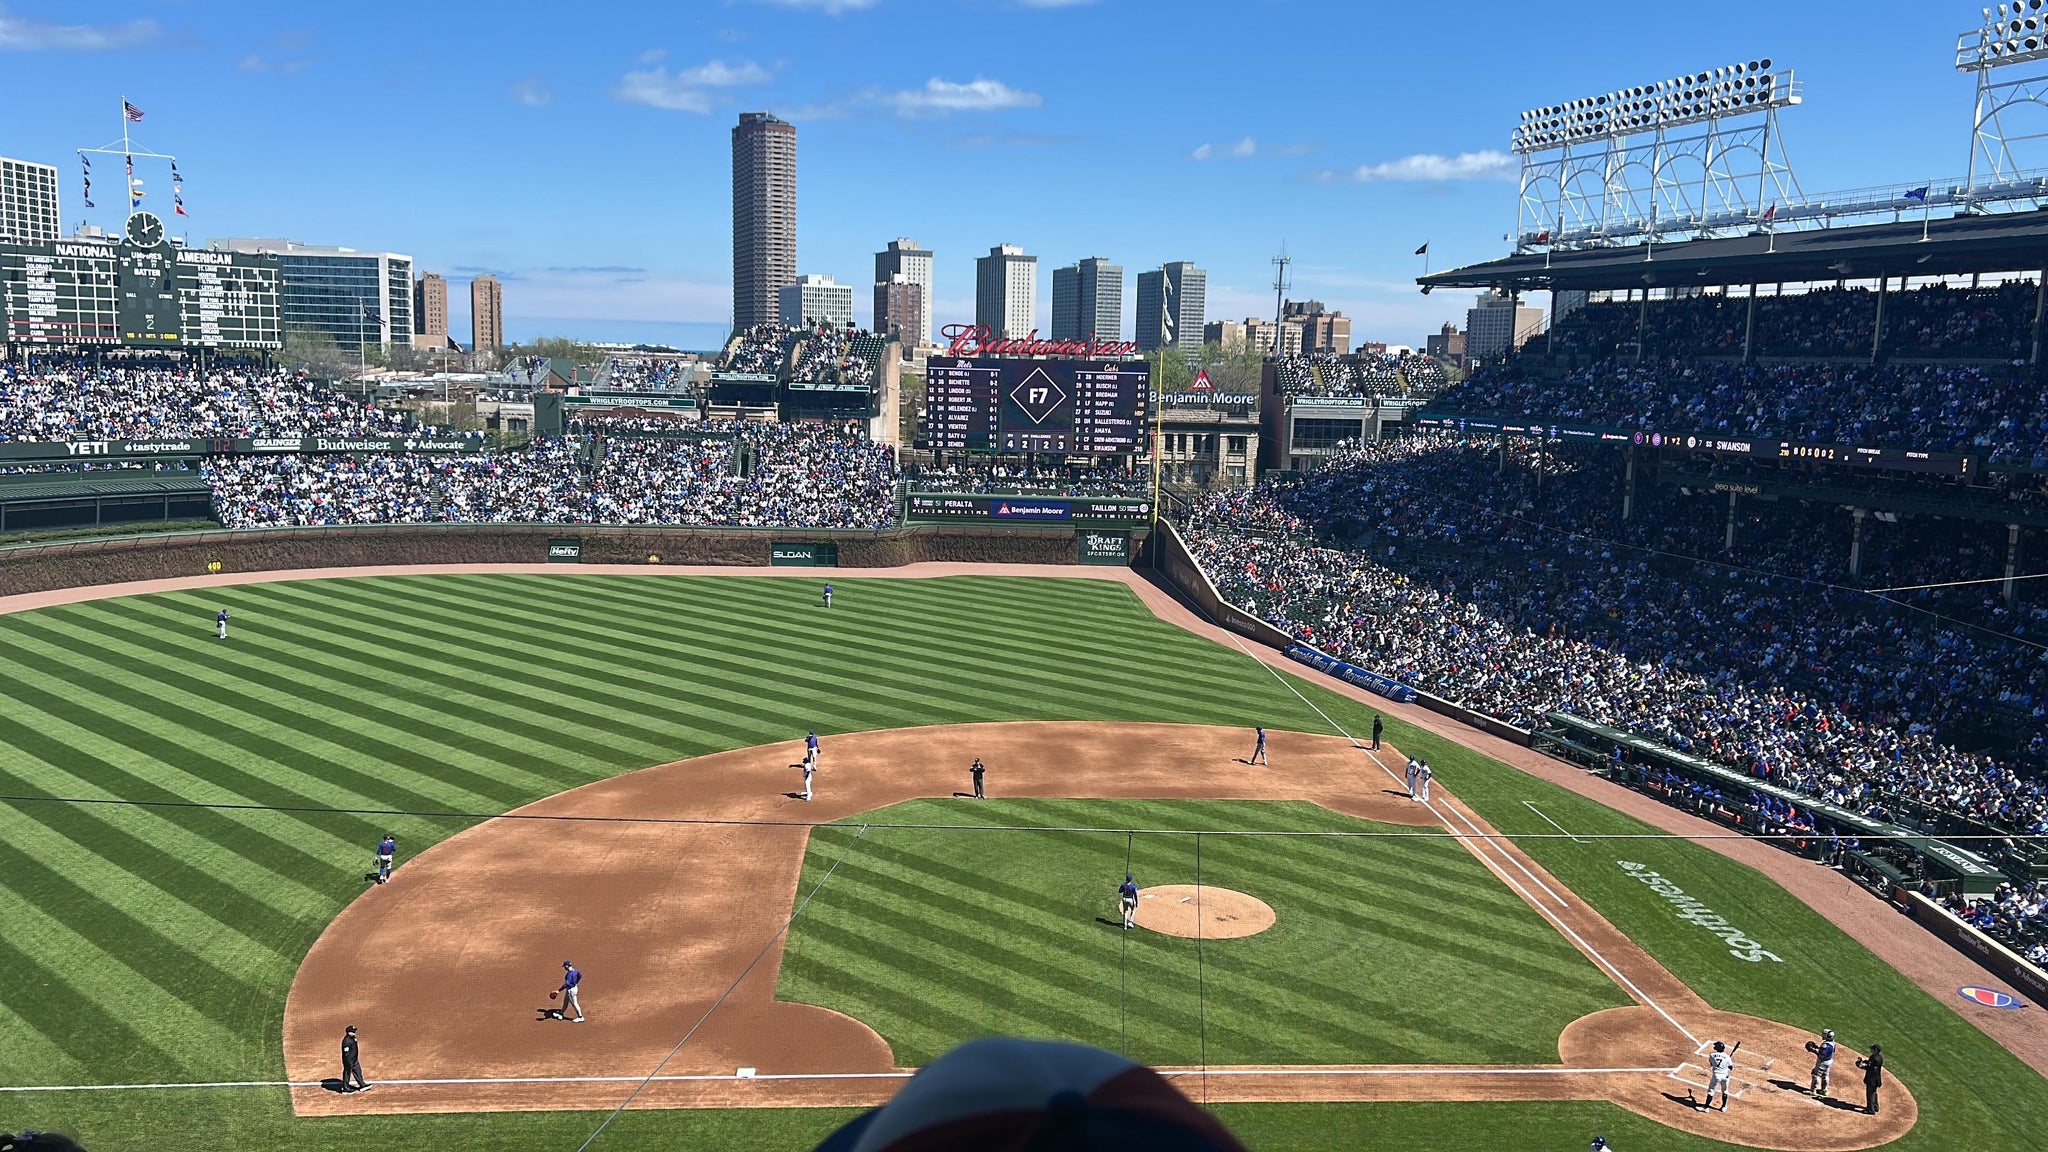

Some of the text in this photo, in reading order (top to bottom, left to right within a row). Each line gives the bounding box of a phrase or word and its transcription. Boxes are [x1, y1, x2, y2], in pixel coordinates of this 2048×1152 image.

[56, 244, 116, 258] NATIONAL
[177, 252, 232, 265] AMERICAN
[134, 268, 160, 276] BATTER
[147, 320, 154, 329] 2
[941, 324, 1138, 356] Budweiser
[956, 360, 972, 368] Mets
[1104, 364, 1118, 372] Cubs
[1030, 388, 1048, 404] F7
[1149, 391, 1254, 405] Benjamin Moore
[590, 397, 668, 406] WRIGLEYROOFTOPS.COM
[418, 440, 464, 449] Advocate
[1007, 440, 1014, 448] 4
[1058, 441, 1064, 449] 3
[1646, 435, 1649, 443] 1
[1664, 436, 1667, 445] 1
[65, 442, 190, 454] YETI tastytrade
[1716, 441, 1750, 452] SWANSON
[1800, 447, 1805, 456] 0
[1814, 448, 1819, 457] 0
[1828, 449, 1834, 459] 2
[1745, 485, 1758, 494] level
[1087, 535, 1123, 545] DRAFT
[552, 547, 577, 555] Hefty
[1343, 668, 1390, 695] Reynolds Wrap
[1625, 871, 1784, 962] Southwest
[1716, 1059, 1722, 1067] 7
